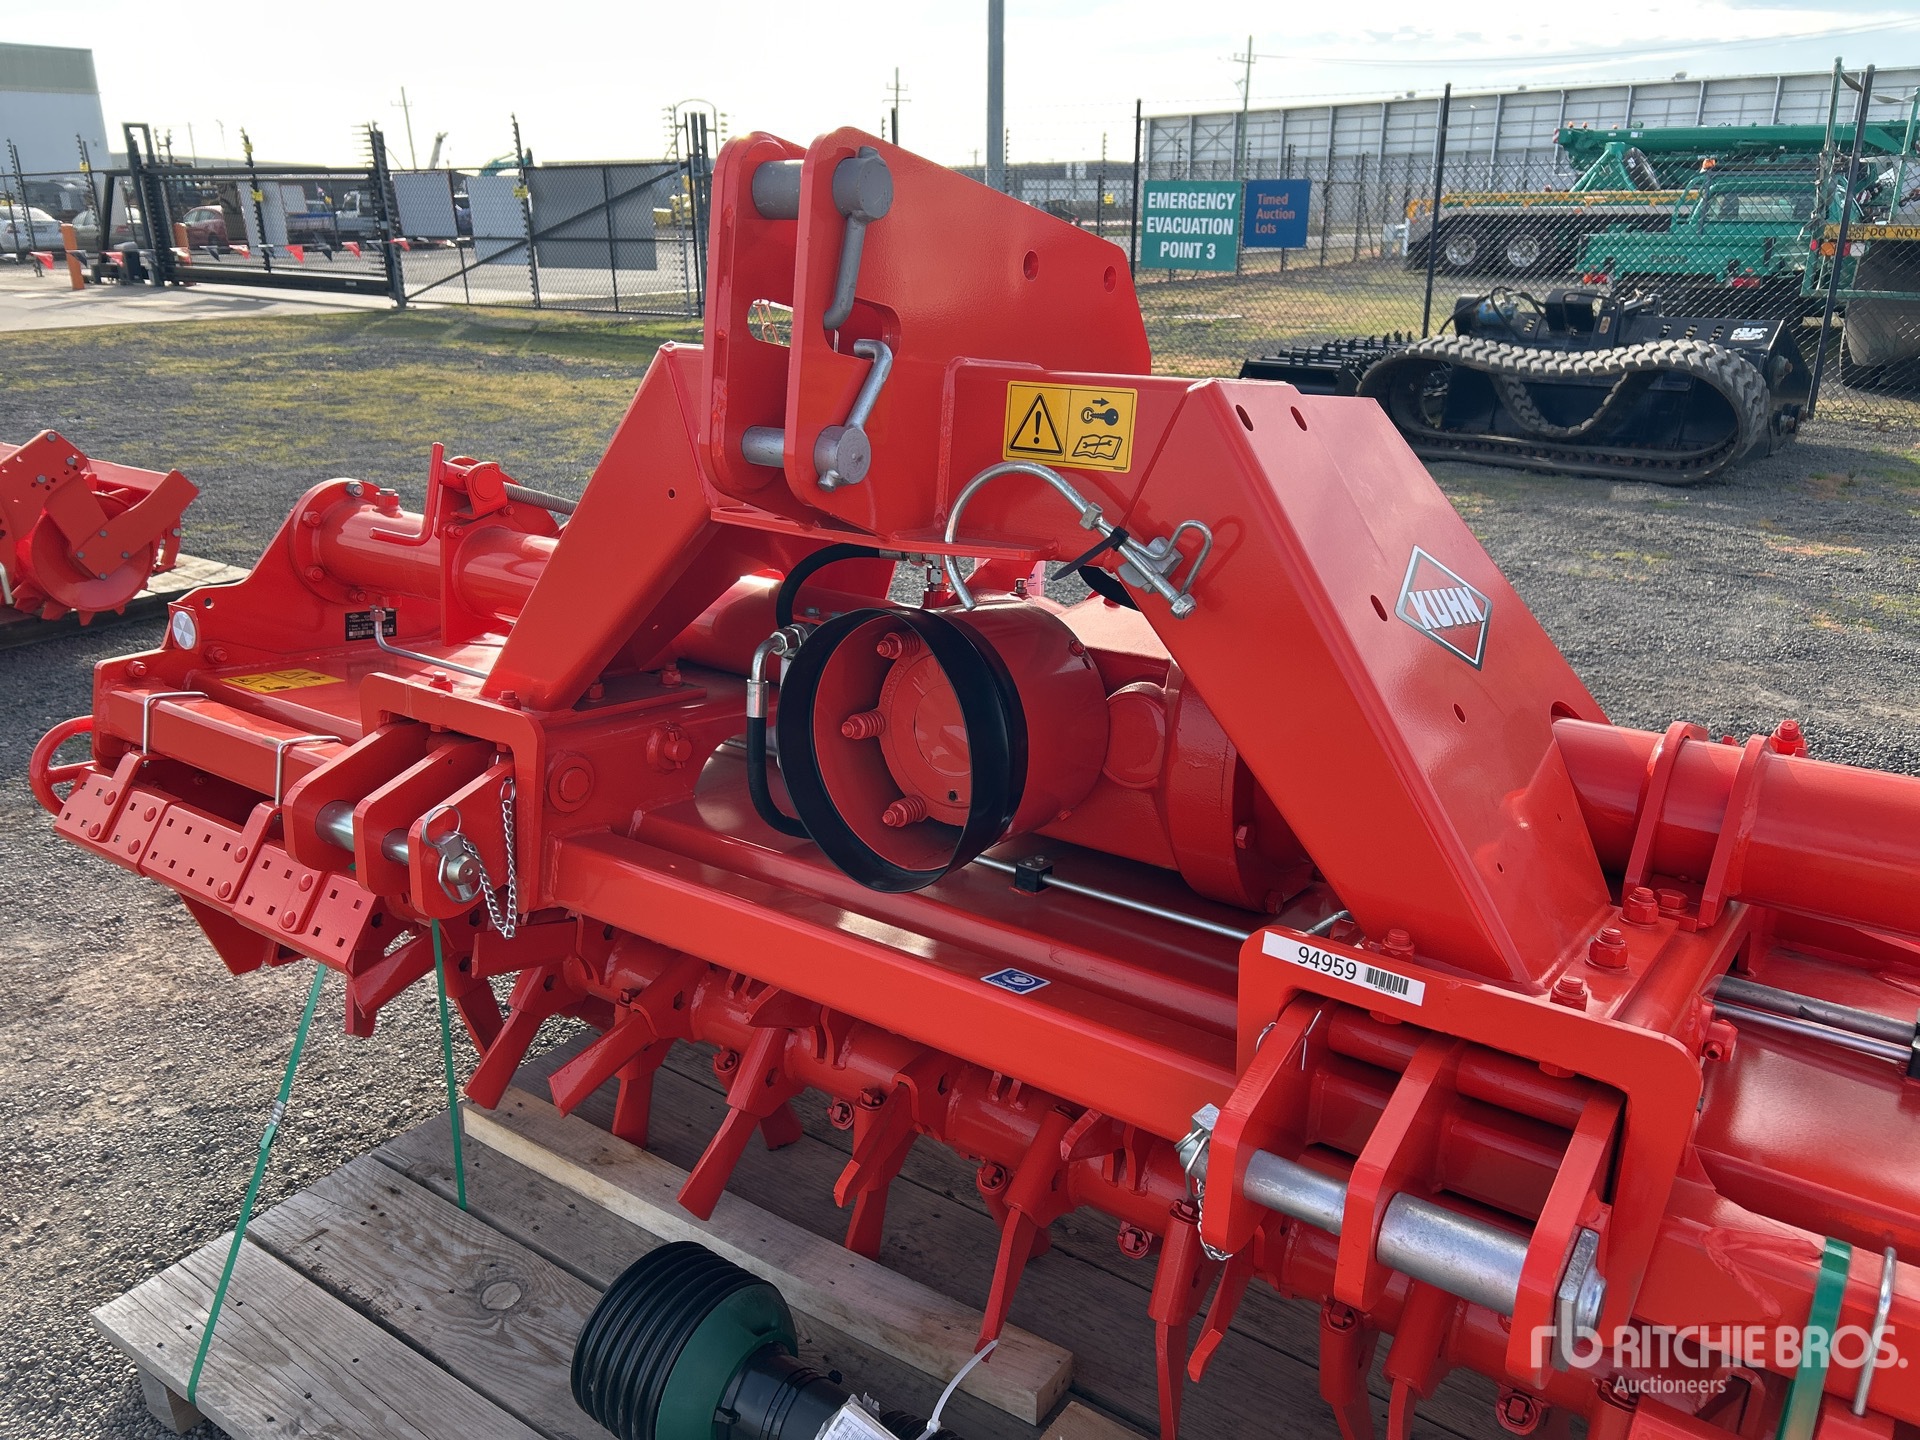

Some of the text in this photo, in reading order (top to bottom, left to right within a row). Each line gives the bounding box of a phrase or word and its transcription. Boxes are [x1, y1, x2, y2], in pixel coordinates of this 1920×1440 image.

[1147, 192, 1236, 210] EMERGENCY
[1257, 193, 1289, 206] Timed
[1256, 207, 1296, 220] Auction
[1146, 217, 1234, 235] EVACUATION
[1255, 222, 1277, 234] Lots
[1870, 228, 1887, 237] DO
[1159, 241, 1216, 260] POINT 3
[1407, 586, 1484, 630] KUHN
[1297, 946, 1357, 980] 94959
